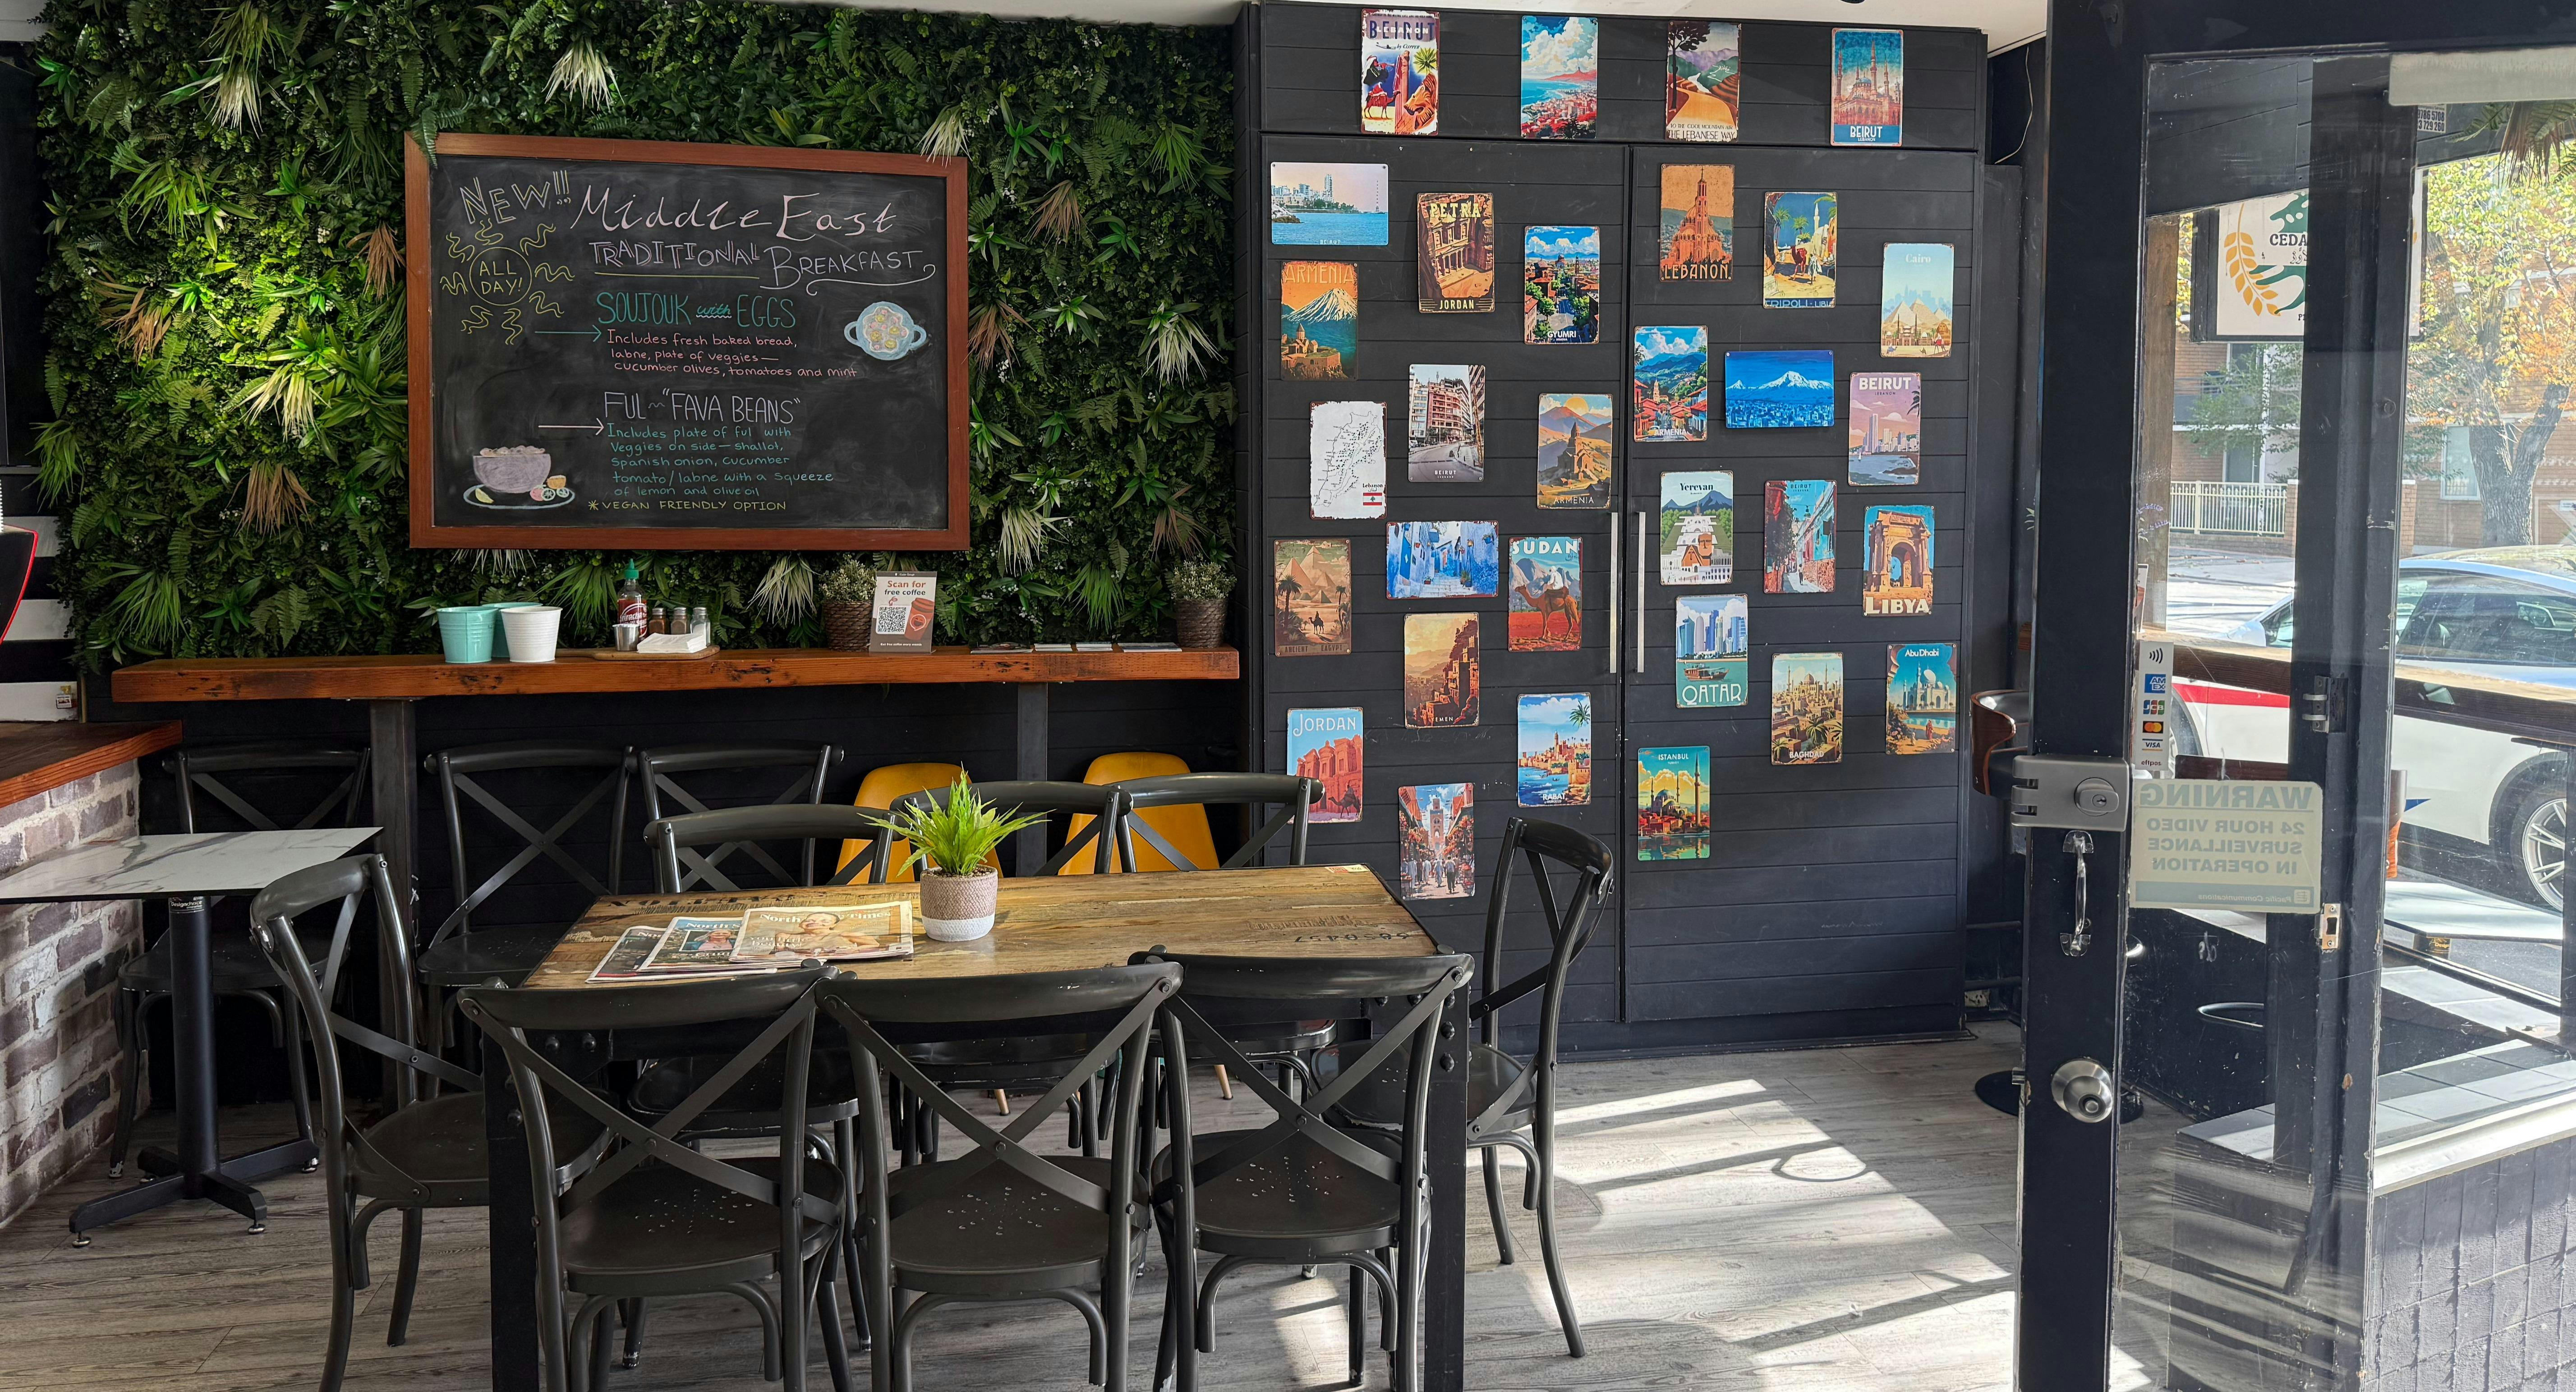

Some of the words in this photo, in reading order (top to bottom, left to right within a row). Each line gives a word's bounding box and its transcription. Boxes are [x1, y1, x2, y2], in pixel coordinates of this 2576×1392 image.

[1370, 20, 1435, 41] BEIRUT
[1376, 26, 1429, 34] LEBANON
[2431, 110, 2445, 122] 5708
[1850, 125, 1883, 138] BEIRUT
[2423, 120, 2433, 130] 729
[2434, 121, 2445, 132] 260
[1668, 129, 1680, 139] THE
[1683, 130, 1718, 140] LEBANESE
[1721, 131, 1735, 140] WAY
[570, 184, 772, 231] Middle
[776, 193, 897, 241] East
[1430, 200, 1481, 218] PETRA
[589, 239, 760, 269] TRADITIONAL
[760, 246, 923, 289] BREAKFAST
[1905, 253, 1931, 263] Cairo
[479, 260, 517, 276] ALL
[1284, 264, 1354, 284] ARMENIA
[1664, 264, 1728, 280] LEBANON
[481, 277, 522, 296] DAY!
[596, 292, 691, 325] SOUJOUK
[696, 303, 732, 316] with
[737, 294, 796, 328] EGGS
[1440, 299, 1475, 310] JORDAN
[607, 329, 668, 345] Includes
[672, 332, 708, 346] fresh
[712, 334, 751, 345] baked
[755, 336, 797, 348] bread,
[1547, 330, 1577, 338] GYUMRI
[611, 349, 651, 361] labne,
[655, 350, 684, 363] plate
[690, 351, 704, 363] of
[614, 362, 678, 372] cucumber
[683, 364, 726, 377] olives,
[728, 367, 792, 377] tomatoes
[797, 368, 822, 377] and
[828, 367, 857, 377] mint
[1859, 377, 1912, 390] BEIRUT
[604, 391, 646, 419] FUL
[607, 423, 667, 438] Includes
[674, 426, 708, 444] plate
[713, 426, 728, 438] of
[735, 426, 751, 438] ful
[764, 427, 791, 436] with
[611, 441, 662, 457] Veggies
[669, 443, 685, 451] on
[611, 457, 670, 470] Spanish
[674, 456, 717, 467] onion,
[722, 456, 790, 465] cucumber
[724, 473, 752, 482] with
[614, 486, 630, 496] of
[637, 486, 675, 495] lemon
[684, 486, 707, 495] and
[713, 486, 741, 495] olive
[745, 487, 759, 496] oil
[1680, 482, 1713, 491] Yerevan
[659, 500, 727, 510] FRIENDLY
[733, 501, 786, 512] OPTION
[1554, 496, 1594, 505] ARMENIA
[1512, 540, 1578, 555] SUDAN
[887, 580, 909, 588] Scan
[912, 580, 926, 588] for
[1865, 596, 1931, 614] LIBYA
[1904, 648, 1919, 657] Abu
[1919, 648, 1939, 657] Dhabi
[1682, 683, 1742, 706] QATAR
[1293, 713, 1356, 737] JORDAN
[760, 914, 801, 923] North
[847, 911, 891, 919] Times
